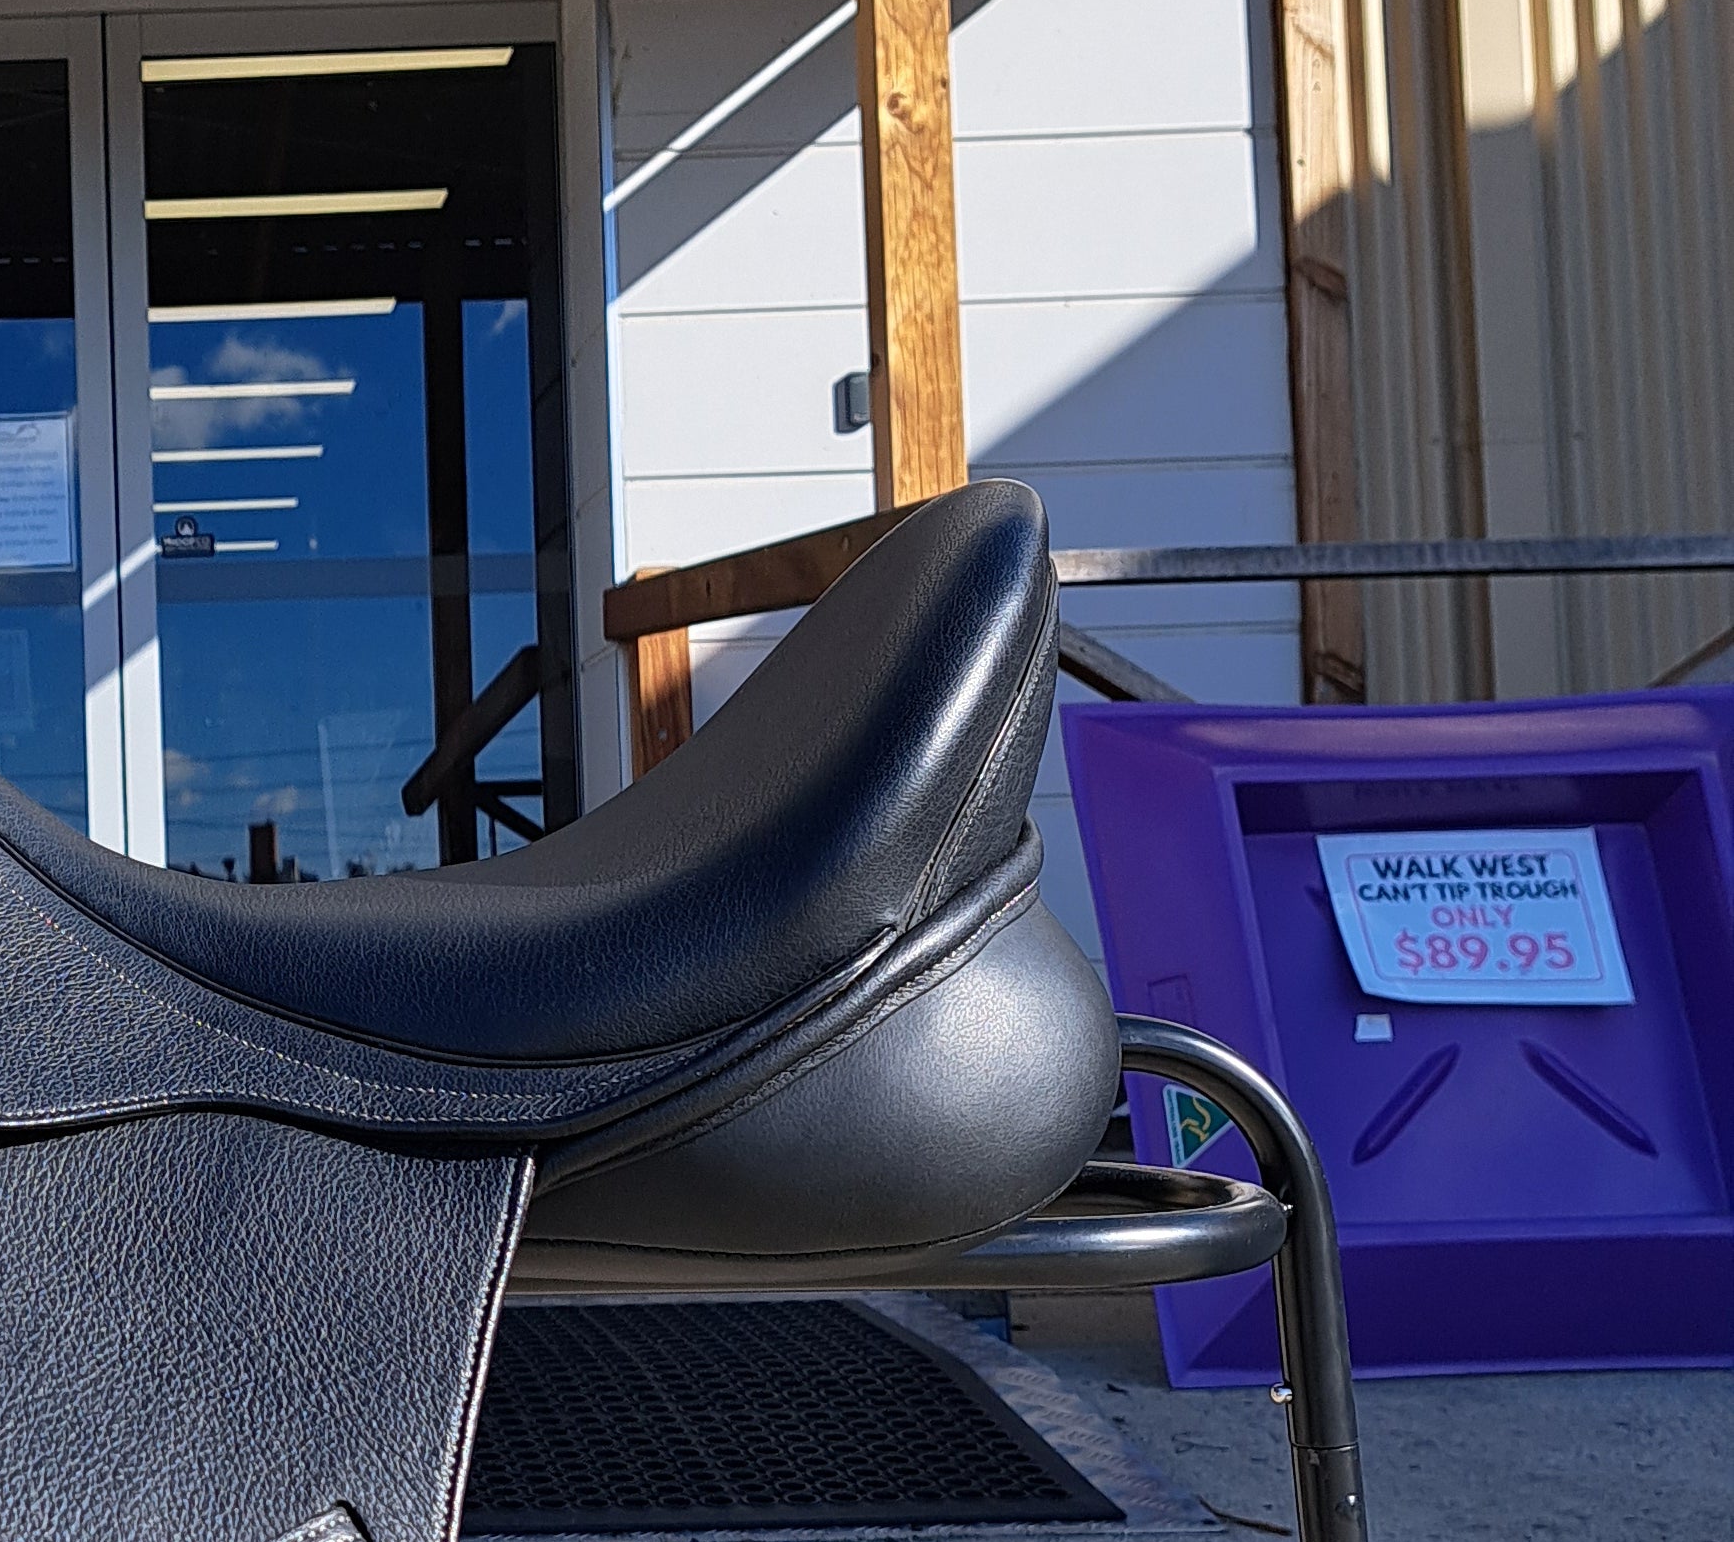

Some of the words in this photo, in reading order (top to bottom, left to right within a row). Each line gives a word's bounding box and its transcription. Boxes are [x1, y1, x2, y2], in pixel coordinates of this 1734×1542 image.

[1372, 854, 1464, 880] WALK
[1467, 853, 1549, 879] WEST
[1358, 881, 1429, 902] CAN'T
[1434, 881, 1470, 902] TIP
[1473, 879, 1579, 901] TROUGH
[1431, 905, 1515, 928] ONLY
[1395, 929, 1576, 975] $89.95
